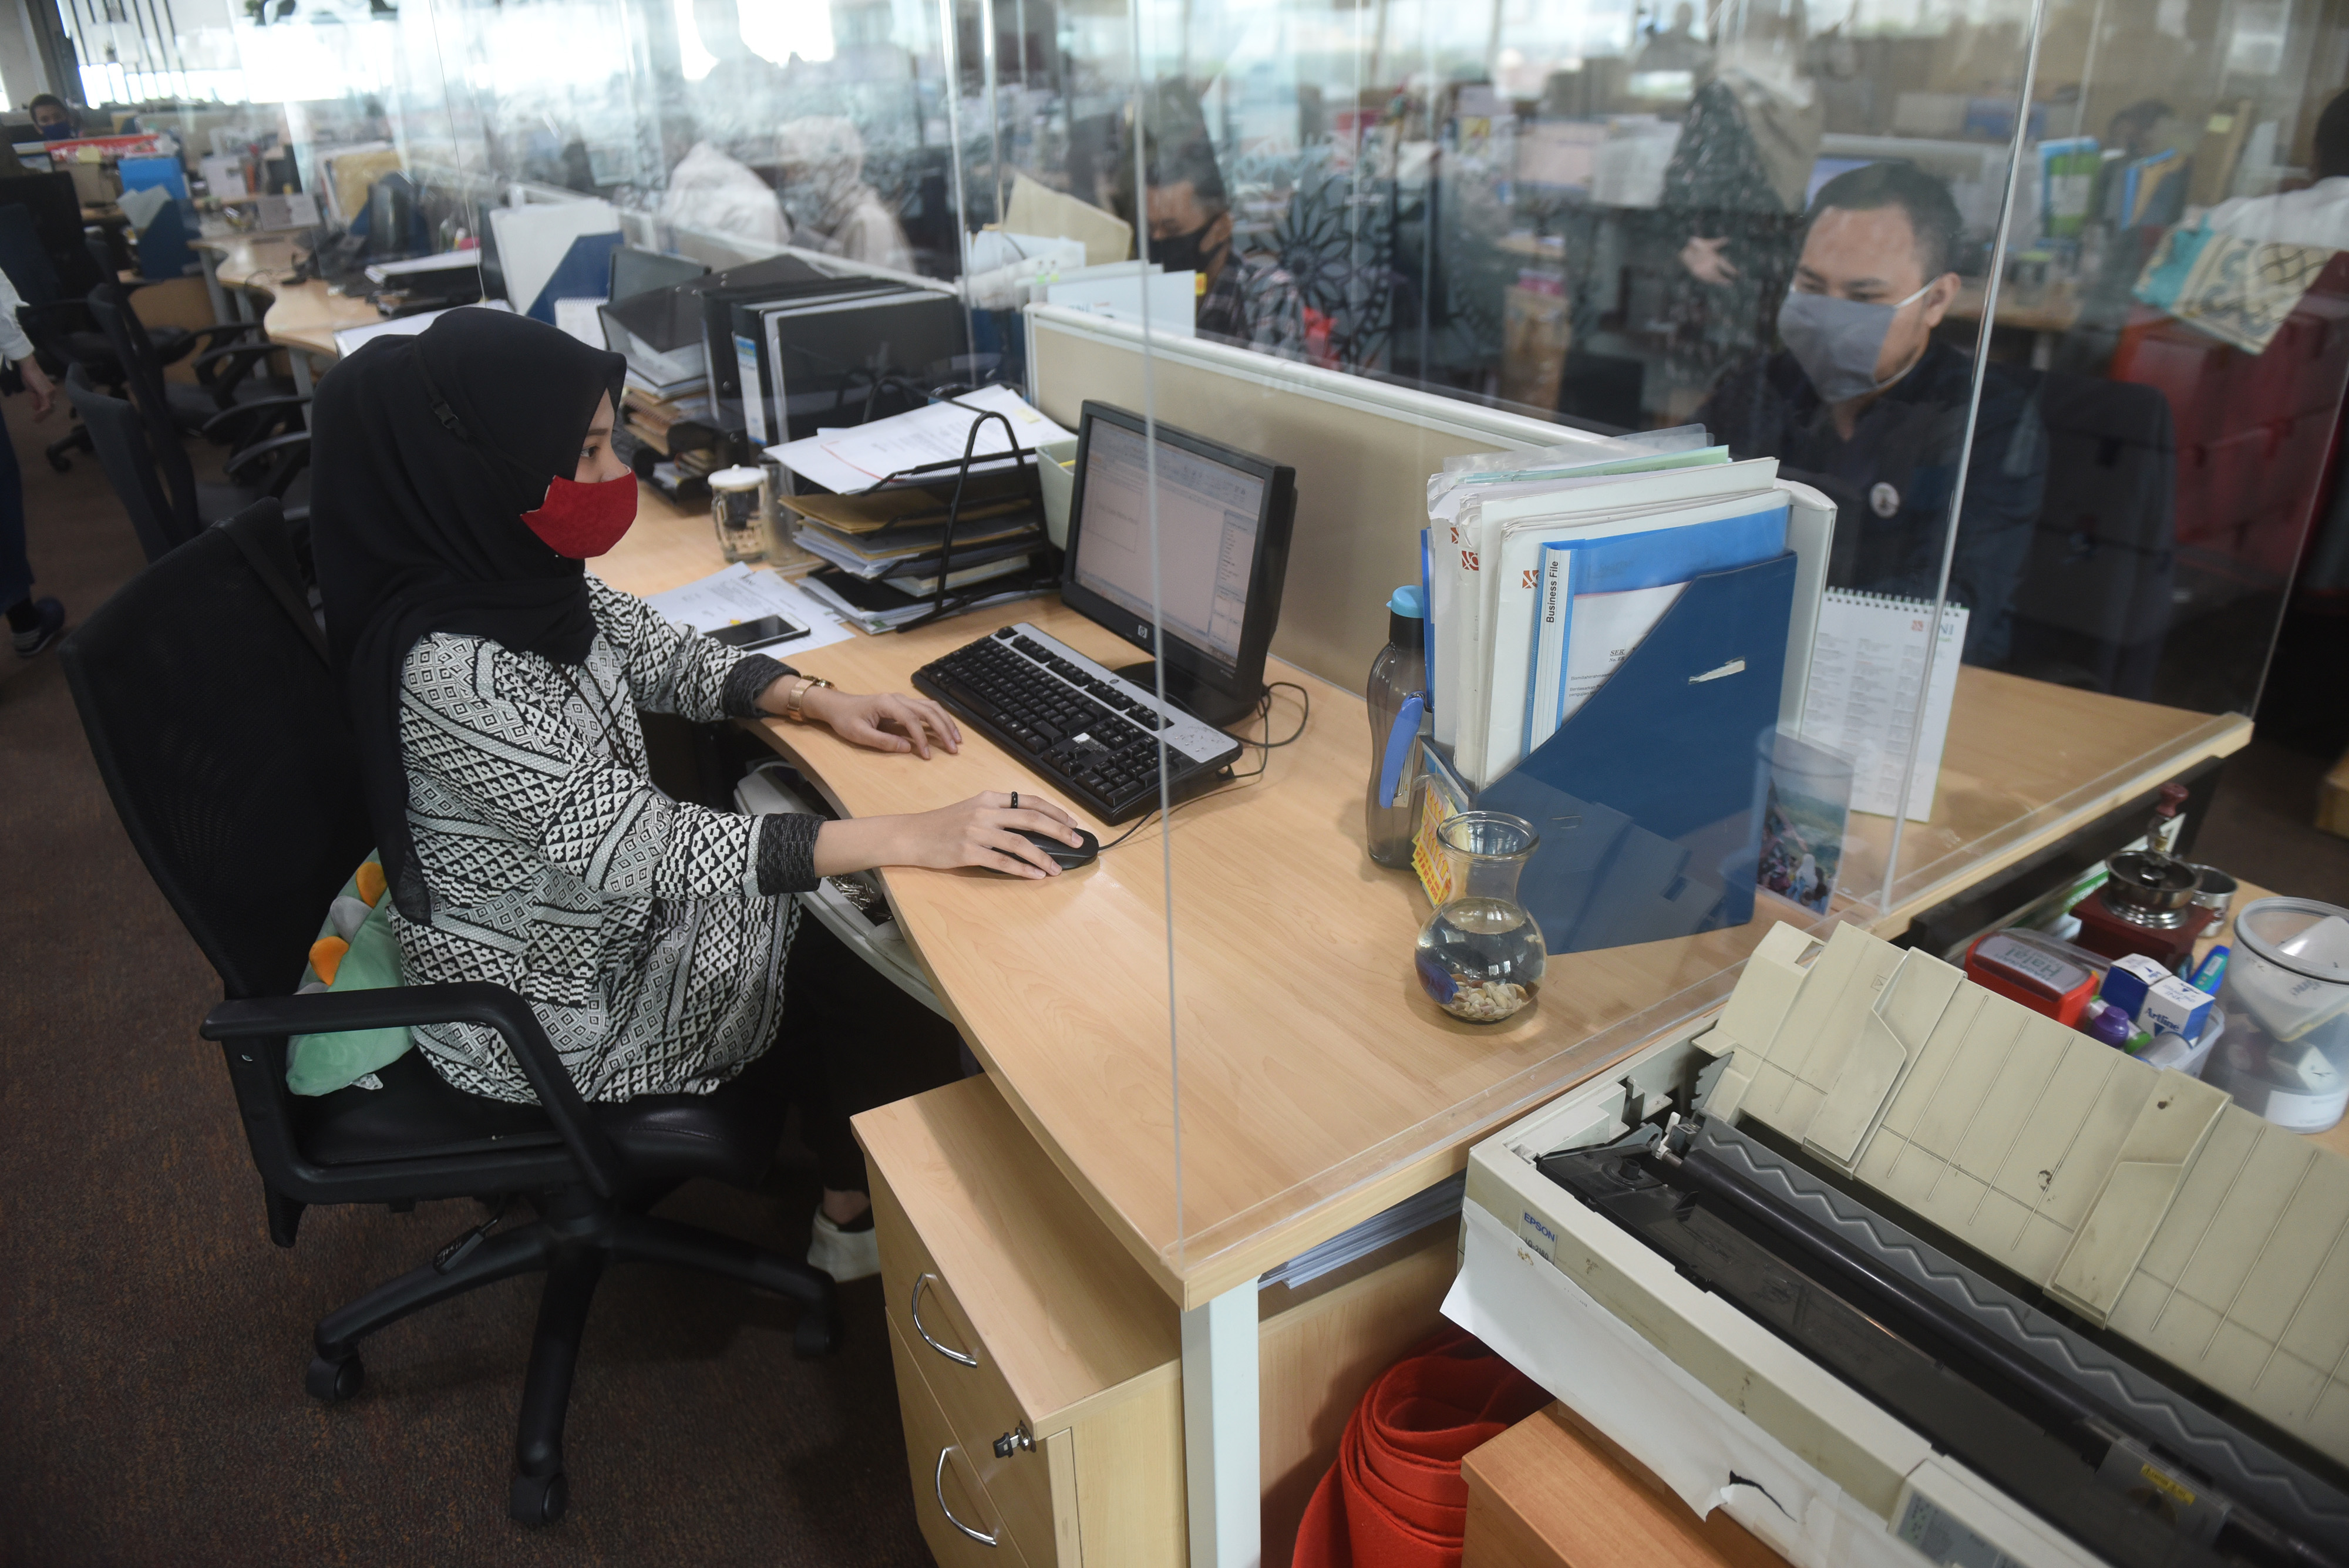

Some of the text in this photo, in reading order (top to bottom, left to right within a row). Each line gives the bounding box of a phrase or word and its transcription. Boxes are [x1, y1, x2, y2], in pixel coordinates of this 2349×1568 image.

[1546, 561, 1559, 623] Business File
[2146, 1007, 2180, 1032] Artline
[1524, 1212, 1555, 1242] EPSON
